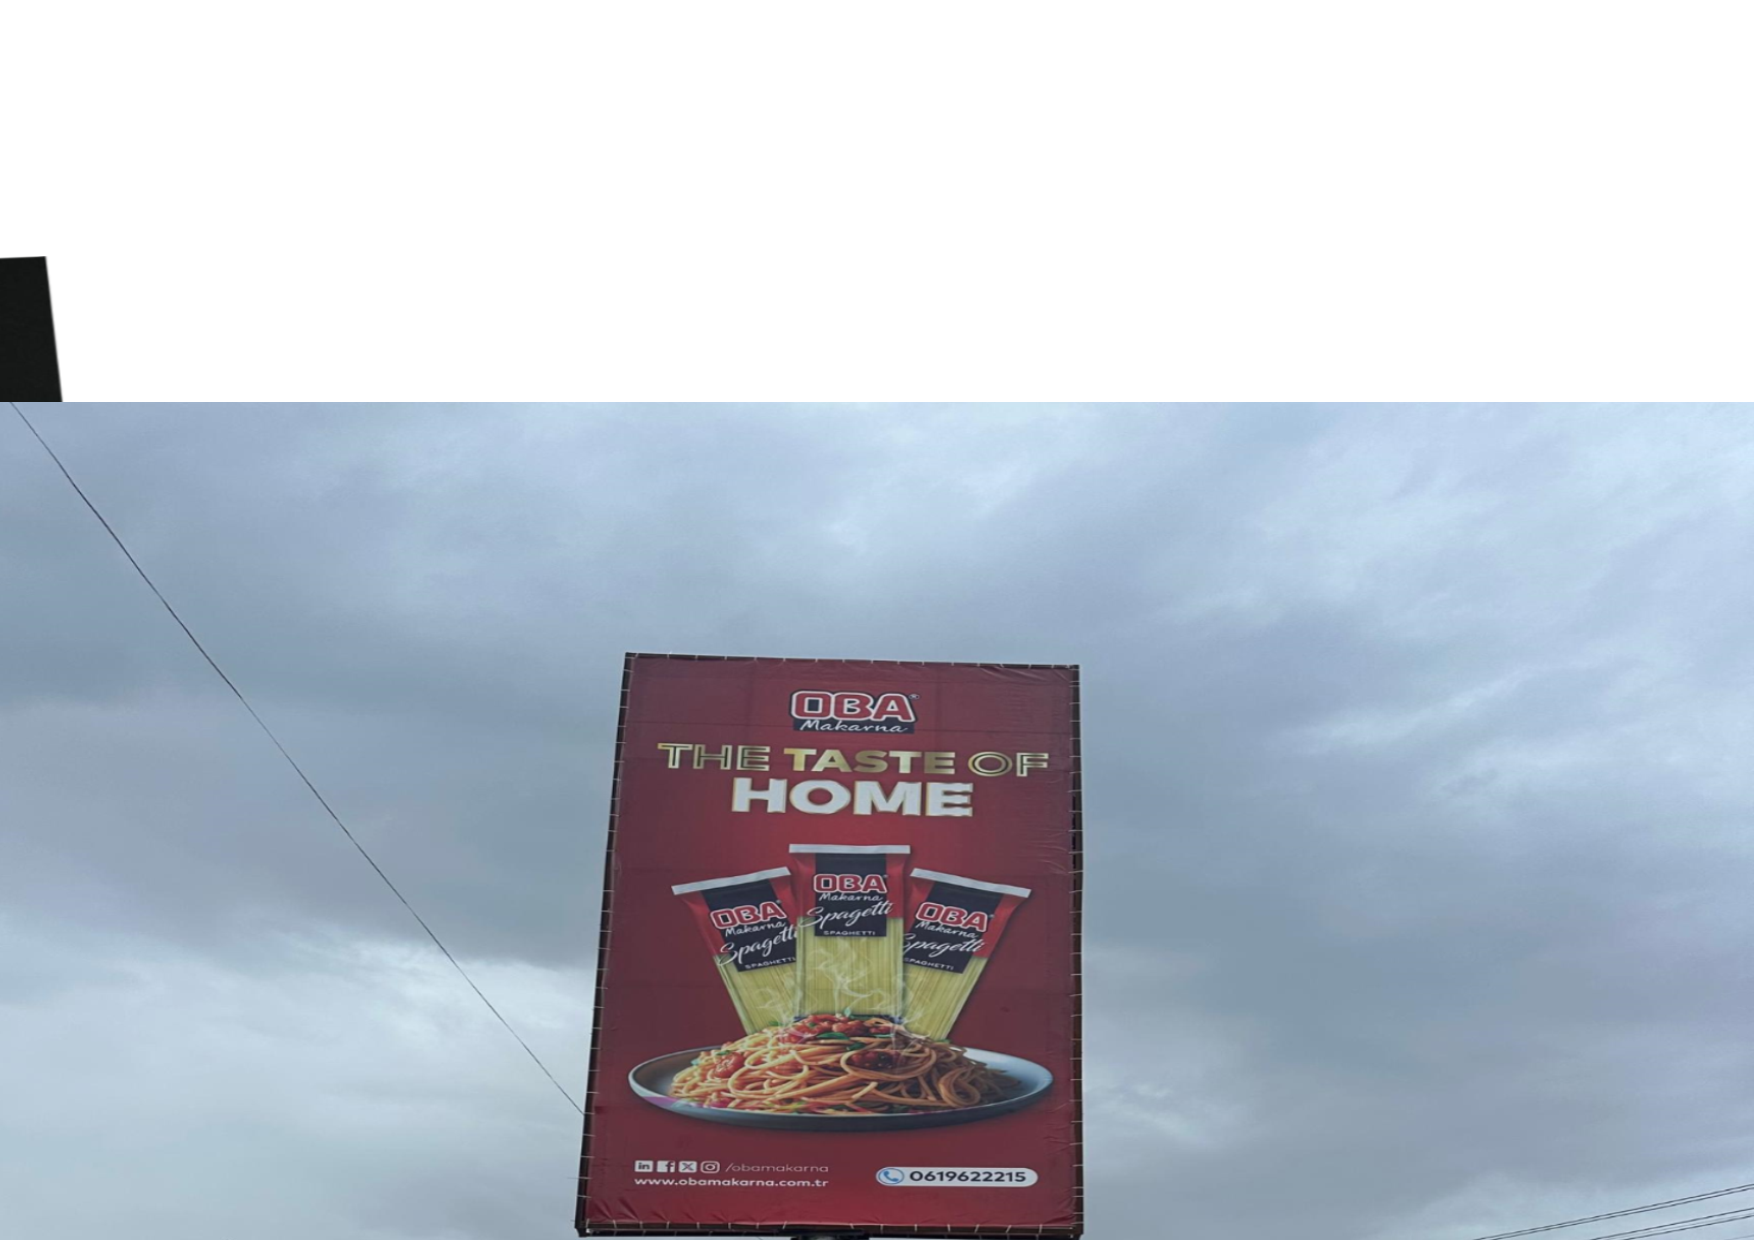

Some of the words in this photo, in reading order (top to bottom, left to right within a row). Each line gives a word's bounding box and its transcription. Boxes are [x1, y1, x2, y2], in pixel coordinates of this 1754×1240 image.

[790, 690, 916, 723] OBA
[799, 719, 908, 733] Makarna
[657, 742, 771, 772] THE
[783, 748, 956, 775] TASTE
[967, 751, 1049, 777] OF
[731, 777, 974, 817] HOME
[813, 873, 888, 893] OBA
[818, 892, 883, 902] Makarna
[710, 901, 787, 929] OBA
[798, 900, 895, 930] Spagetti
[915, 902, 988, 933] OBA
[725, 921, 786, 937] Makarna
[915, 921, 979, 939] Makarna
[725, 1162, 829, 1173] /obamakarna
[909, 1170, 1026, 1183] 0619622215
[633, 1177, 829, 1188] www.obamakarna.com.tr
